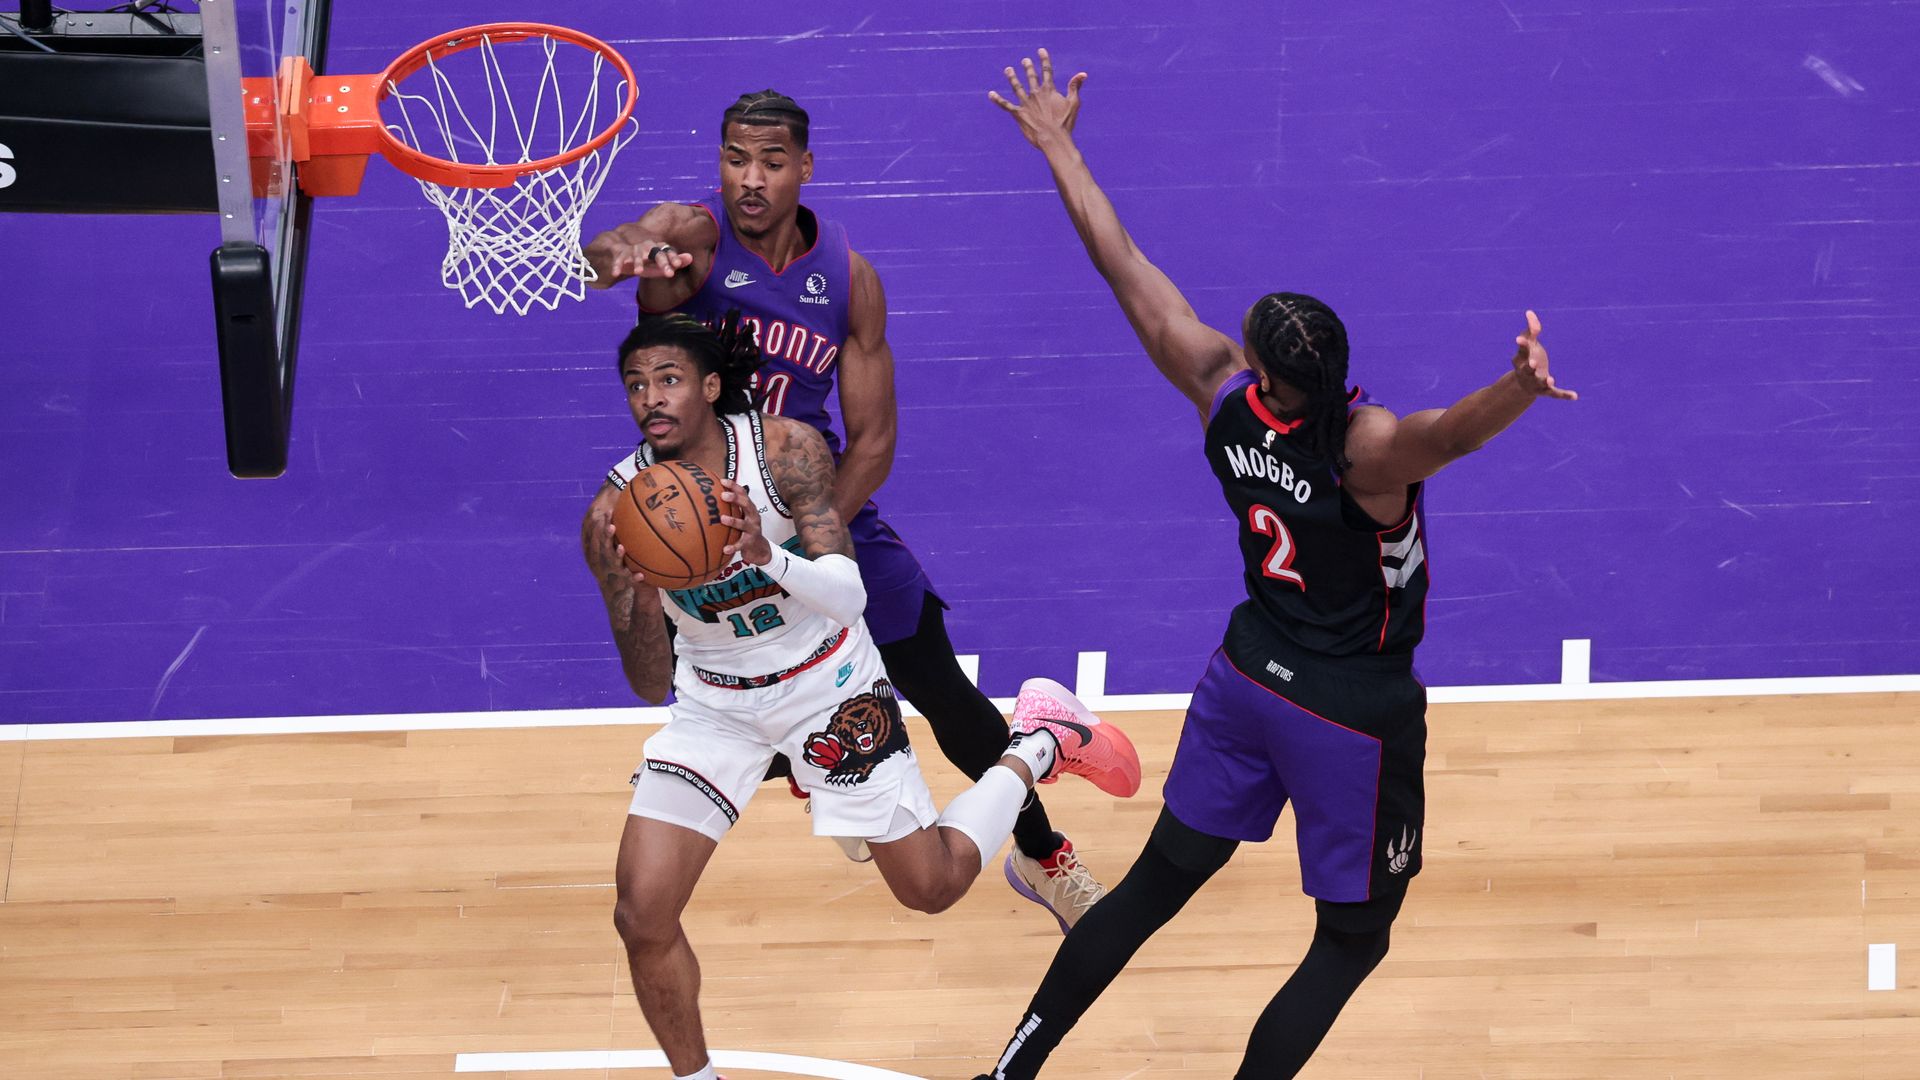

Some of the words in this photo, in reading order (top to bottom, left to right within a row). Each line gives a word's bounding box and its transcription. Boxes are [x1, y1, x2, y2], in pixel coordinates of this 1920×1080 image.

[729, 270, 749, 282] NIKE
[799, 294, 814, 304] Sun
[814, 296, 830, 305] Life
[701, 316, 839, 375] RONTO
[1224, 444, 1312, 504] MOGBO
[1248, 503, 1306, 593] 2
[726, 603, 786, 638] 12
